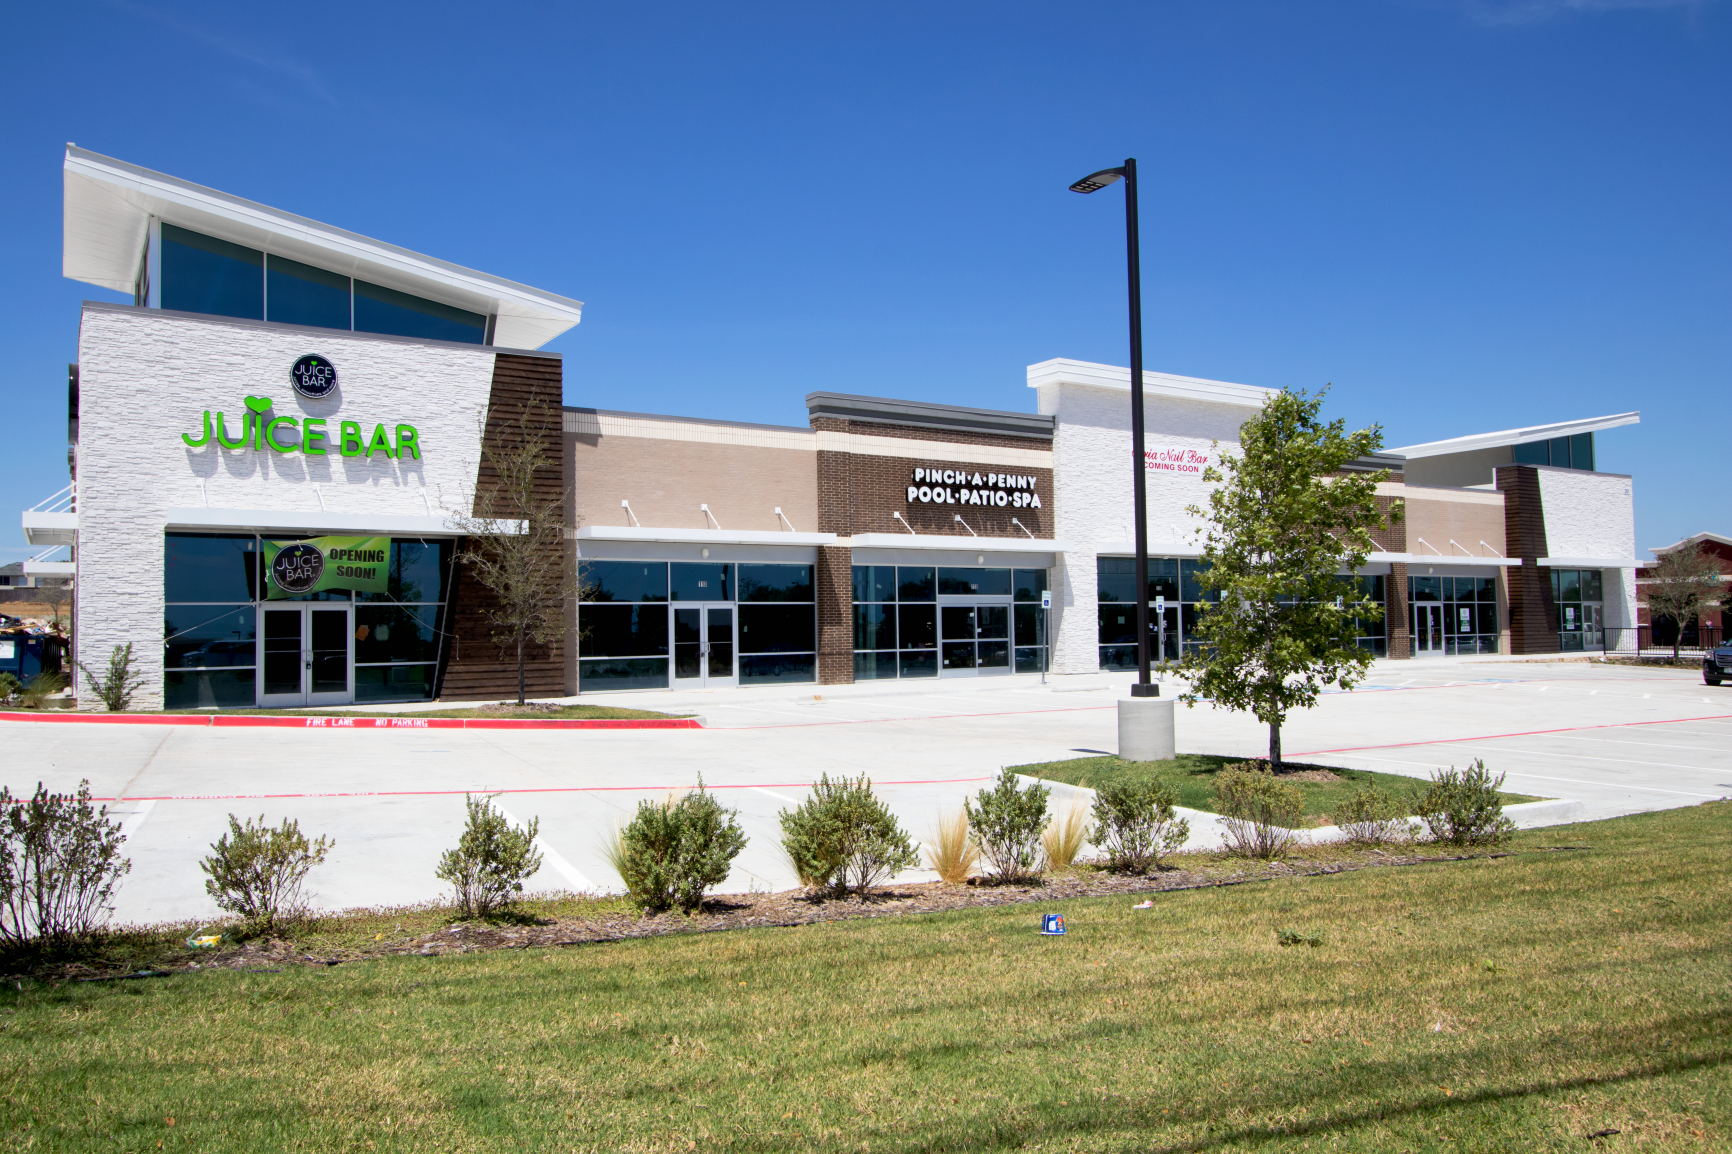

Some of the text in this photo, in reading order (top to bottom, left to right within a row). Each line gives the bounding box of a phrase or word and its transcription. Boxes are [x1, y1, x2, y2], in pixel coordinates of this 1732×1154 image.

[294, 364, 332, 377] JUICE
[302, 375, 325, 387] BAR
[181, 408, 421, 460] JUICE BAR
[1132, 449, 1208, 464] ria Nail Bar
[1144, 461, 1199, 473] COMING SOON
[276, 554, 319, 570] JUICE
[329, 548, 385, 563] OPENING
[286, 567, 312, 581] BAR
[336, 565, 376, 580] SOON!
[306, 718, 428, 728] FIRE LANE NO PARKING
